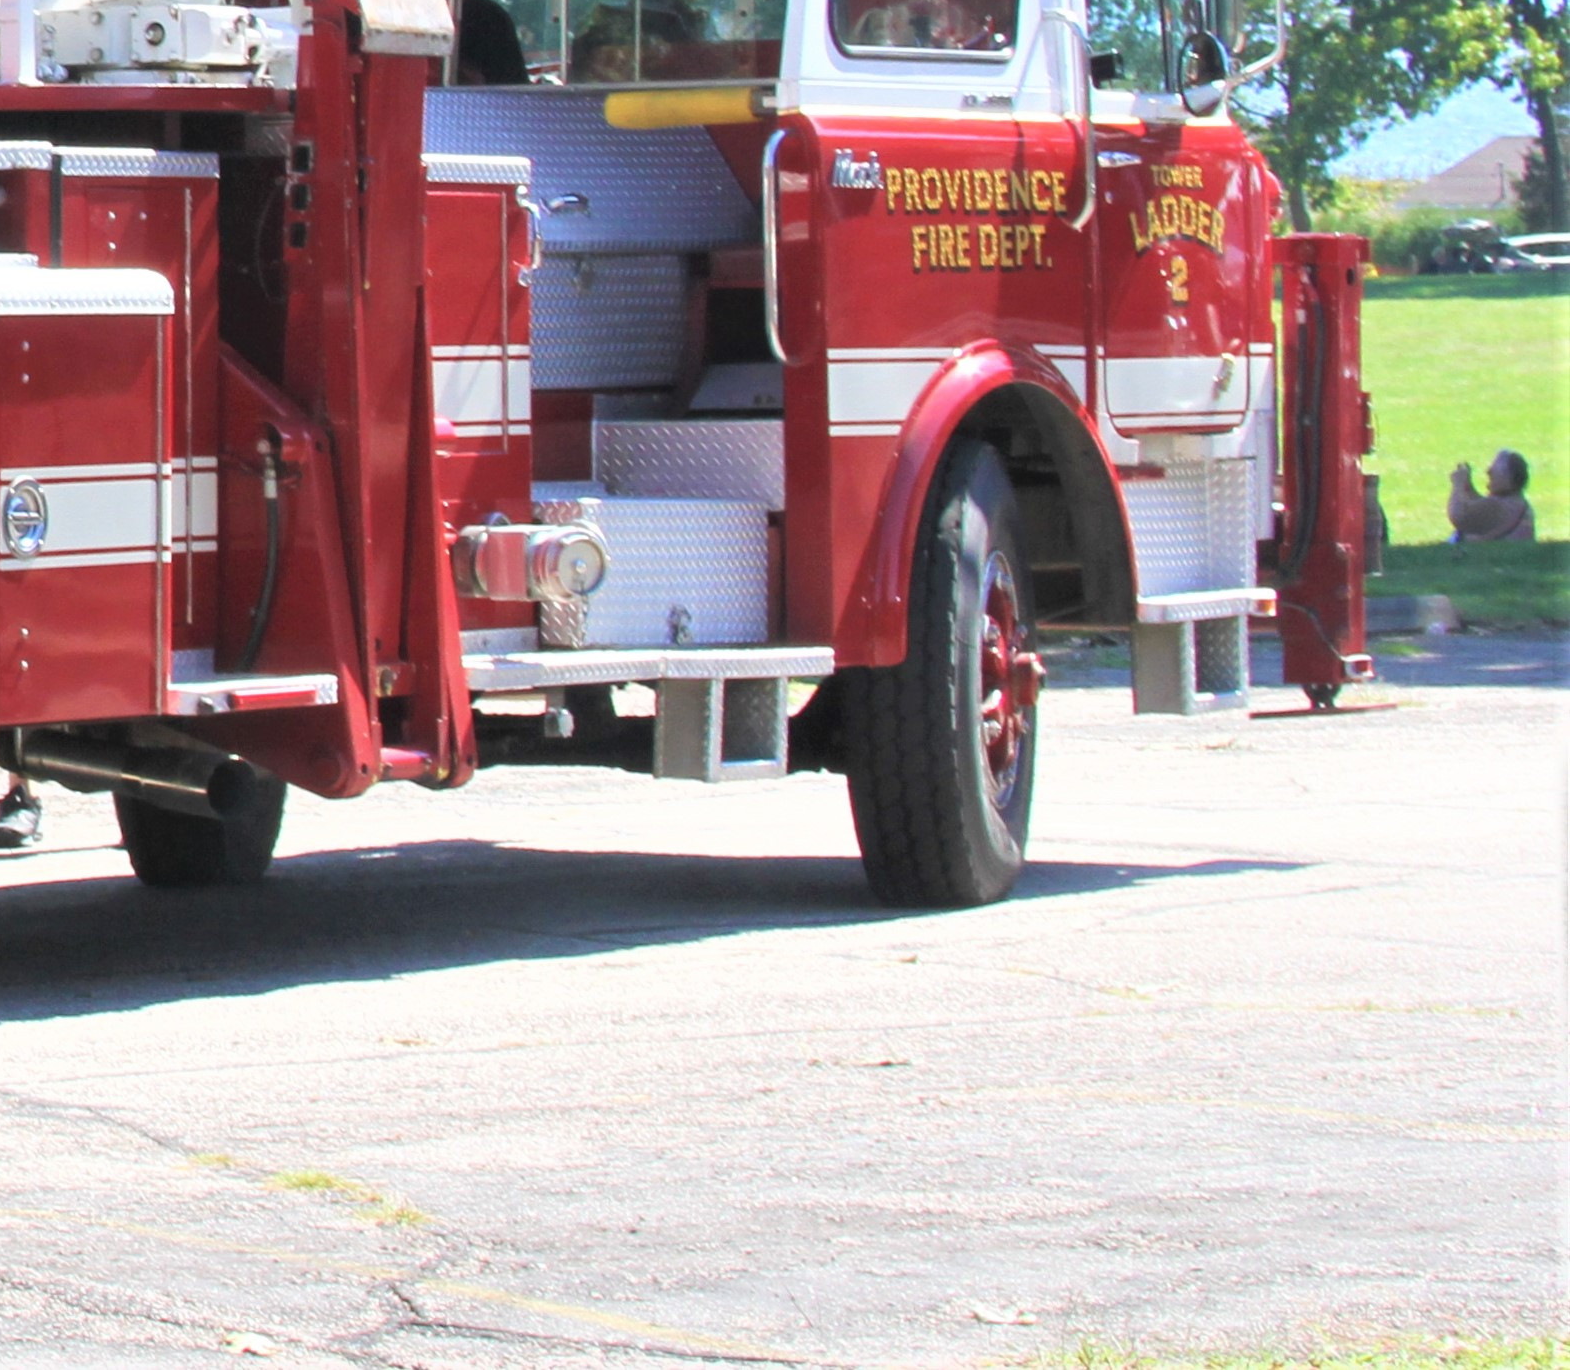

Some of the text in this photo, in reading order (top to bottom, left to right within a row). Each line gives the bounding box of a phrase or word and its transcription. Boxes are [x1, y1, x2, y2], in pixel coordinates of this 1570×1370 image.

[886, 167, 1067, 216] PROVIDENCE
[1150, 164, 1203, 189] TOWER
[912, 224, 1054, 274] FIRE DEPT.
[1129, 197, 1225, 255] LADDER
[1169, 255, 1190, 306] 2
